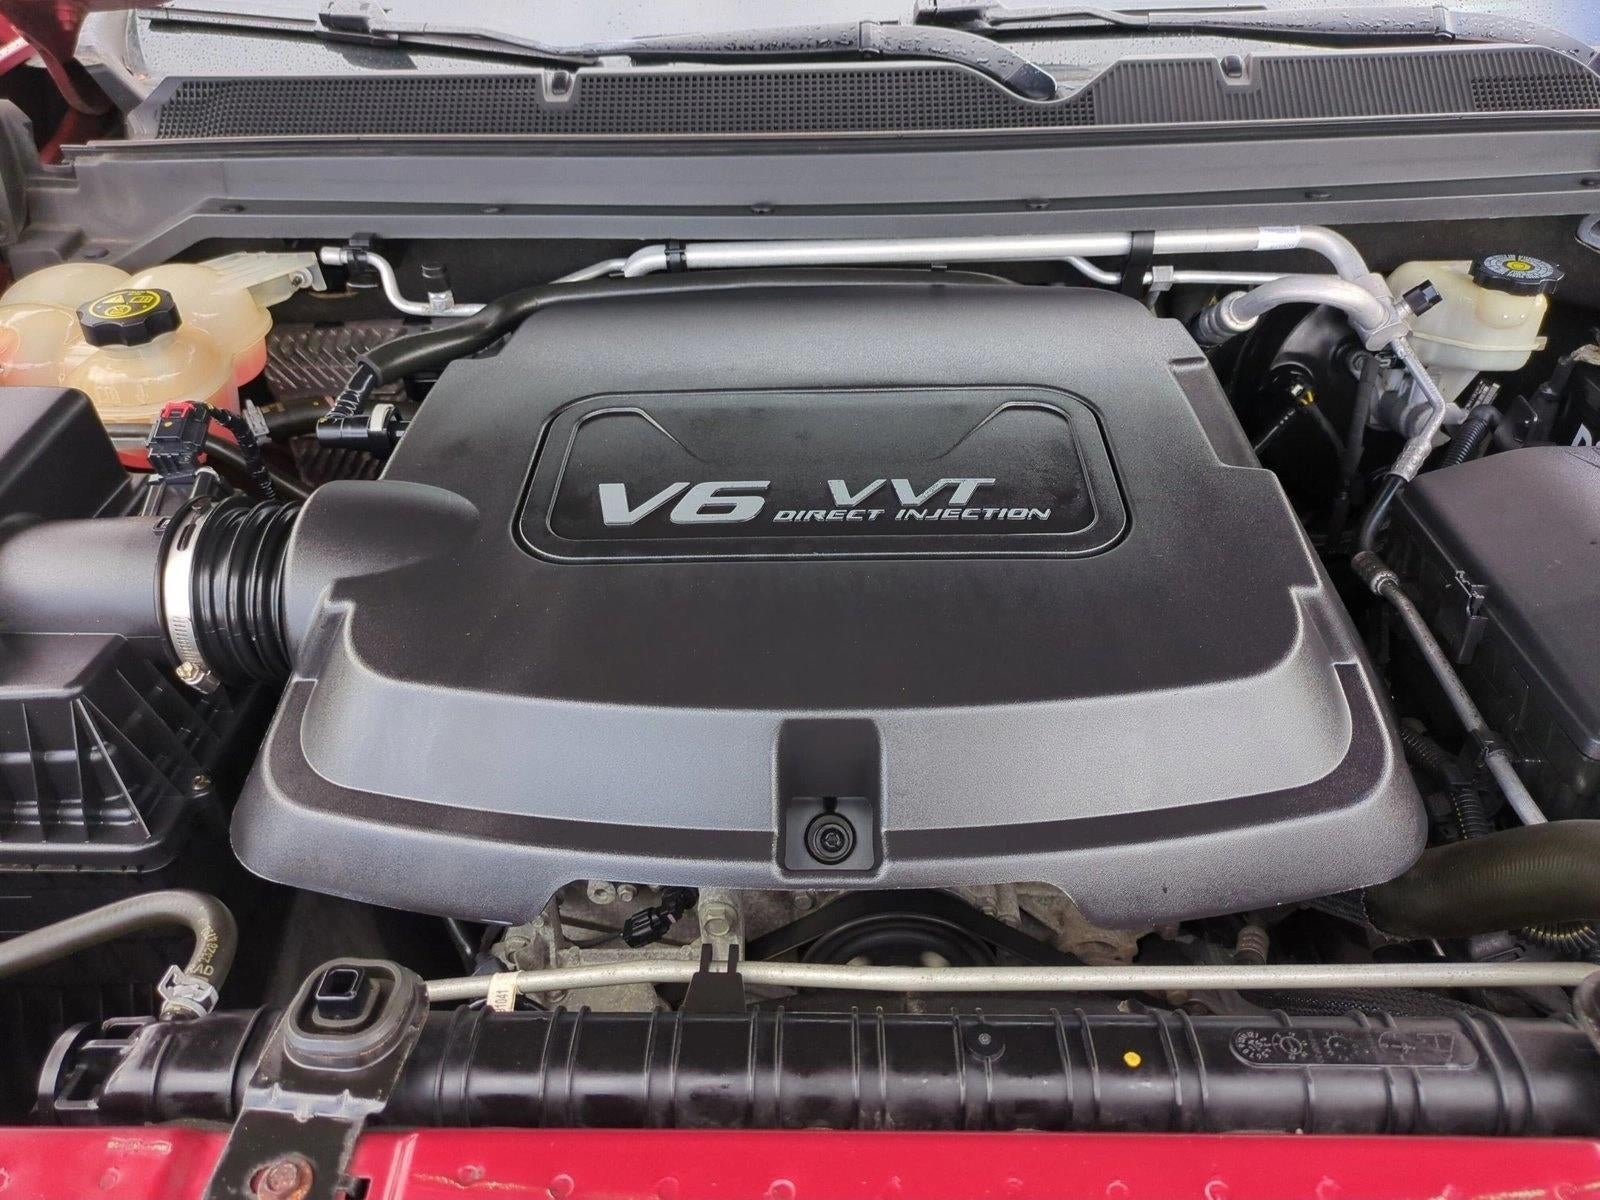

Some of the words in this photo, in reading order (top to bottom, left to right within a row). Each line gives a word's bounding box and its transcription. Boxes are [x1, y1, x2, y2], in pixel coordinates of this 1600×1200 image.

[598, 480, 771, 526] V6
[827, 478, 996, 507] VVT
[773, 509, 886, 522] DIRECT
[895, 508, 1051, 521] INJECTION
